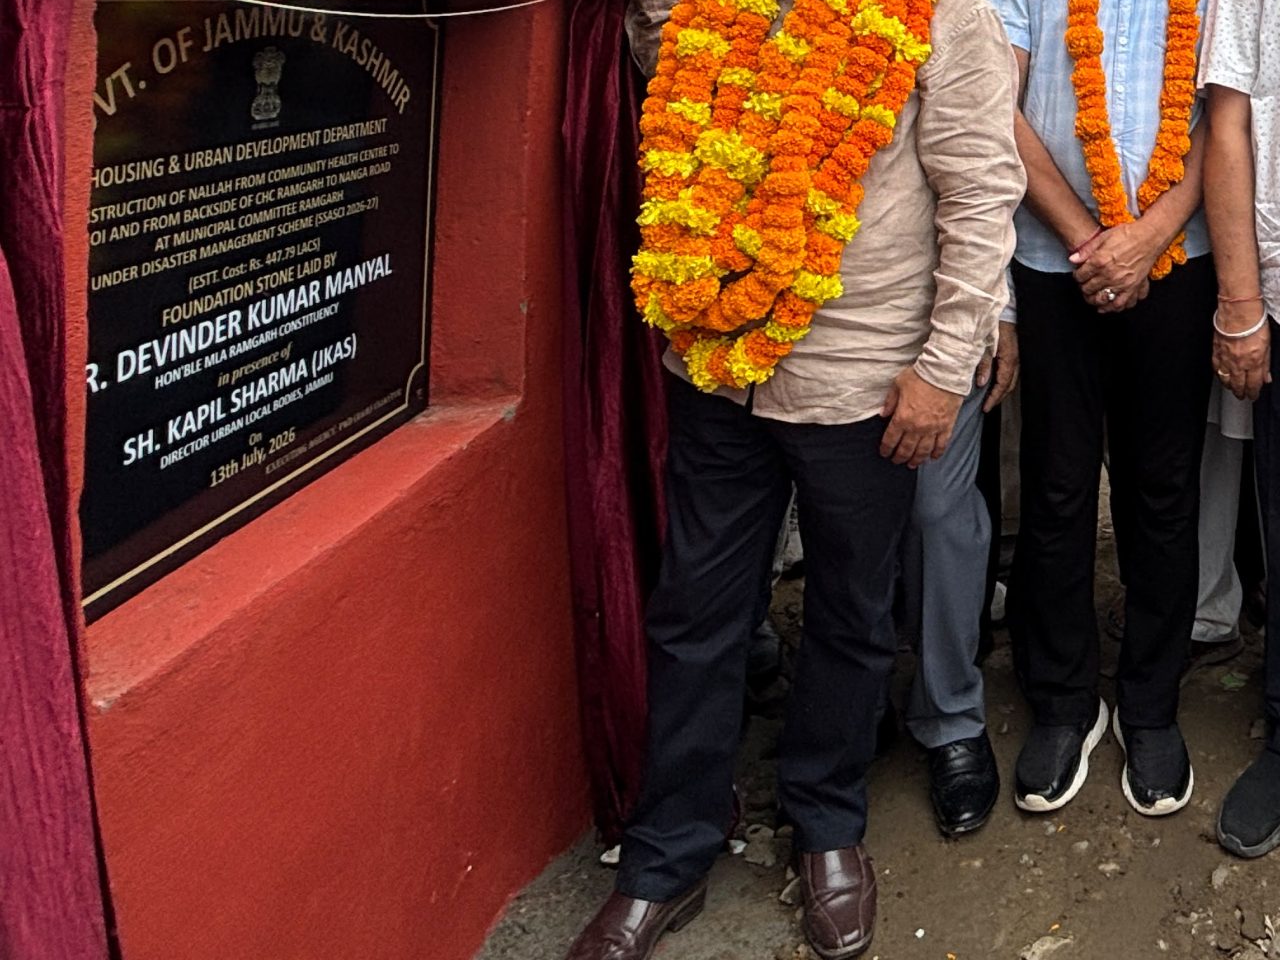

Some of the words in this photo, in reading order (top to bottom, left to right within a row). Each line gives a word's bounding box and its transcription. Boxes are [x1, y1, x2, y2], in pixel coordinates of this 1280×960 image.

[152, 26, 193, 74] OF
[203, 6, 305, 53] JAMMU
[310, 13, 328, 44] &
[332, 20, 411, 114] KASHMIR
[168, 154, 181, 175] &
[184, 146, 234, 172] URBAN
[235, 130, 323, 162] DEVELOPMENT
[323, 118, 388, 145] DEPARTMENT
[169, 190, 187, 206] OF
[189, 179, 233, 202] NALLAH
[235, 173, 266, 191] FROM
[267, 158, 328, 184] COMMUNITY
[328, 151, 359, 170] HEALTH
[359, 144, 389, 163] CENTRE
[389, 142, 400, 156] TO
[109, 221, 140, 242] AND
[143, 211, 181, 234] FROM
[183, 198, 238, 224] BACKSIDE
[239, 193, 254, 210] OF
[255, 188, 276, 206] CHC
[277, 177, 325, 200] RAMGARH
[326, 174, 338, 187] TO
[338, 166, 369, 184] NANGA
[369, 161, 392, 177] ROAD
[154, 234, 172, 253] AT
[173, 218, 236, 247] MUNICIPAL
[238, 201, 298, 230] COMMITTEE
[299, 189, 345, 212] RAMGARH
[91, 265, 139, 292] UNDER
[141, 248, 198, 278] DISASTER
[199, 226, 277, 260] MANAGEMENT
[277, 214, 314, 237] SCHEME
[162, 280, 254, 328] FOUNDATION
[256, 265, 295, 293] STONE
[297, 256, 322, 278] LAID
[323, 251, 338, 269] BY
[222, 263, 248, 281] Cost:
[249, 257, 264, 273] Rs.
[265, 245, 296, 267] 447.79
[116, 309, 243, 384] DEVINDER
[247, 280, 321, 331] KUMAR
[325, 253, 393, 300] MANYAL
[154, 357, 203, 390] HON'BLE
[204, 351, 228, 369] MLA
[229, 326, 278, 357] RAMGARH
[279, 301, 340, 337] CONSTITUENCY
[122, 428, 161, 467] SH.
[167, 396, 226, 444] KAPIL
[230, 357, 309, 413] SHARMA
[312, 332, 358, 378] (JKAS)
[217, 371, 229, 388] in
[230, 350, 279, 386] presence
[280, 340, 293, 361] of
[160, 433, 209, 471] DIRECTOR
[211, 418, 244, 443] URBAN
[245, 407, 272, 426] LOCAL
[304, 371, 334, 396] JAMMU
[209, 458, 239, 487] 13th
[240, 444, 267, 471] July,
[268, 426, 296, 455] 2026
[248, 431, 263, 446] On
